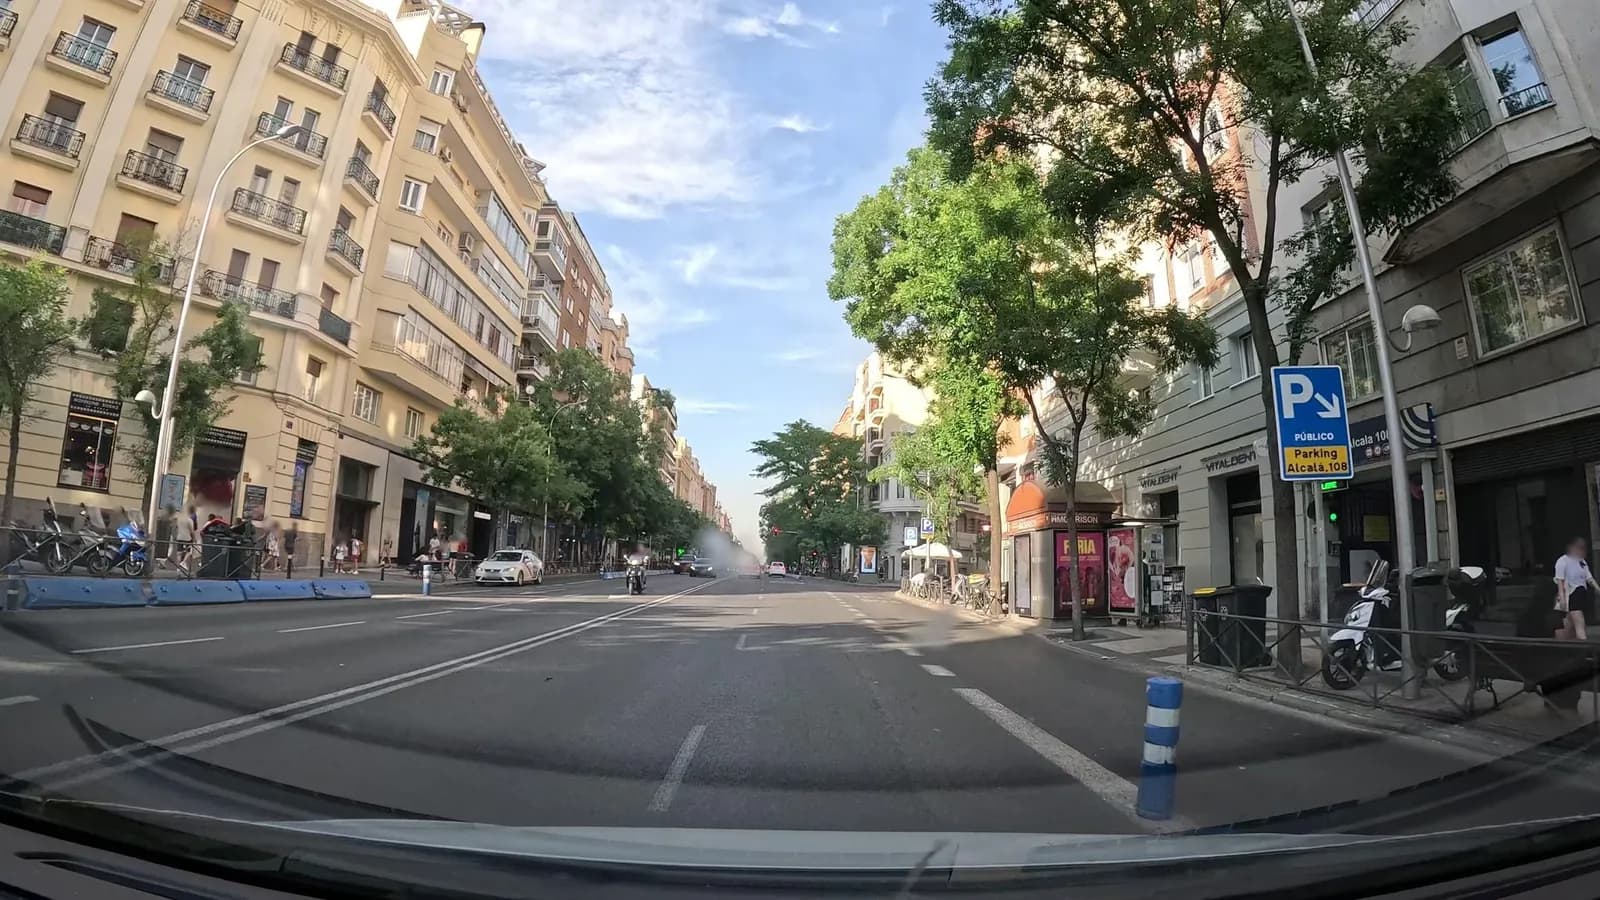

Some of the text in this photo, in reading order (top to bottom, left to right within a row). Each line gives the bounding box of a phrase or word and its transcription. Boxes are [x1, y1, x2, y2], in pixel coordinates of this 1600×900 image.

[1279, 373, 1314, 419] P
[1294, 431, 1335, 441] PÚBLICO
[1350, 434, 1374, 449] lcala
[1294, 448, 1338, 460] Parking
[1063, 539, 1096, 554] FRIA
